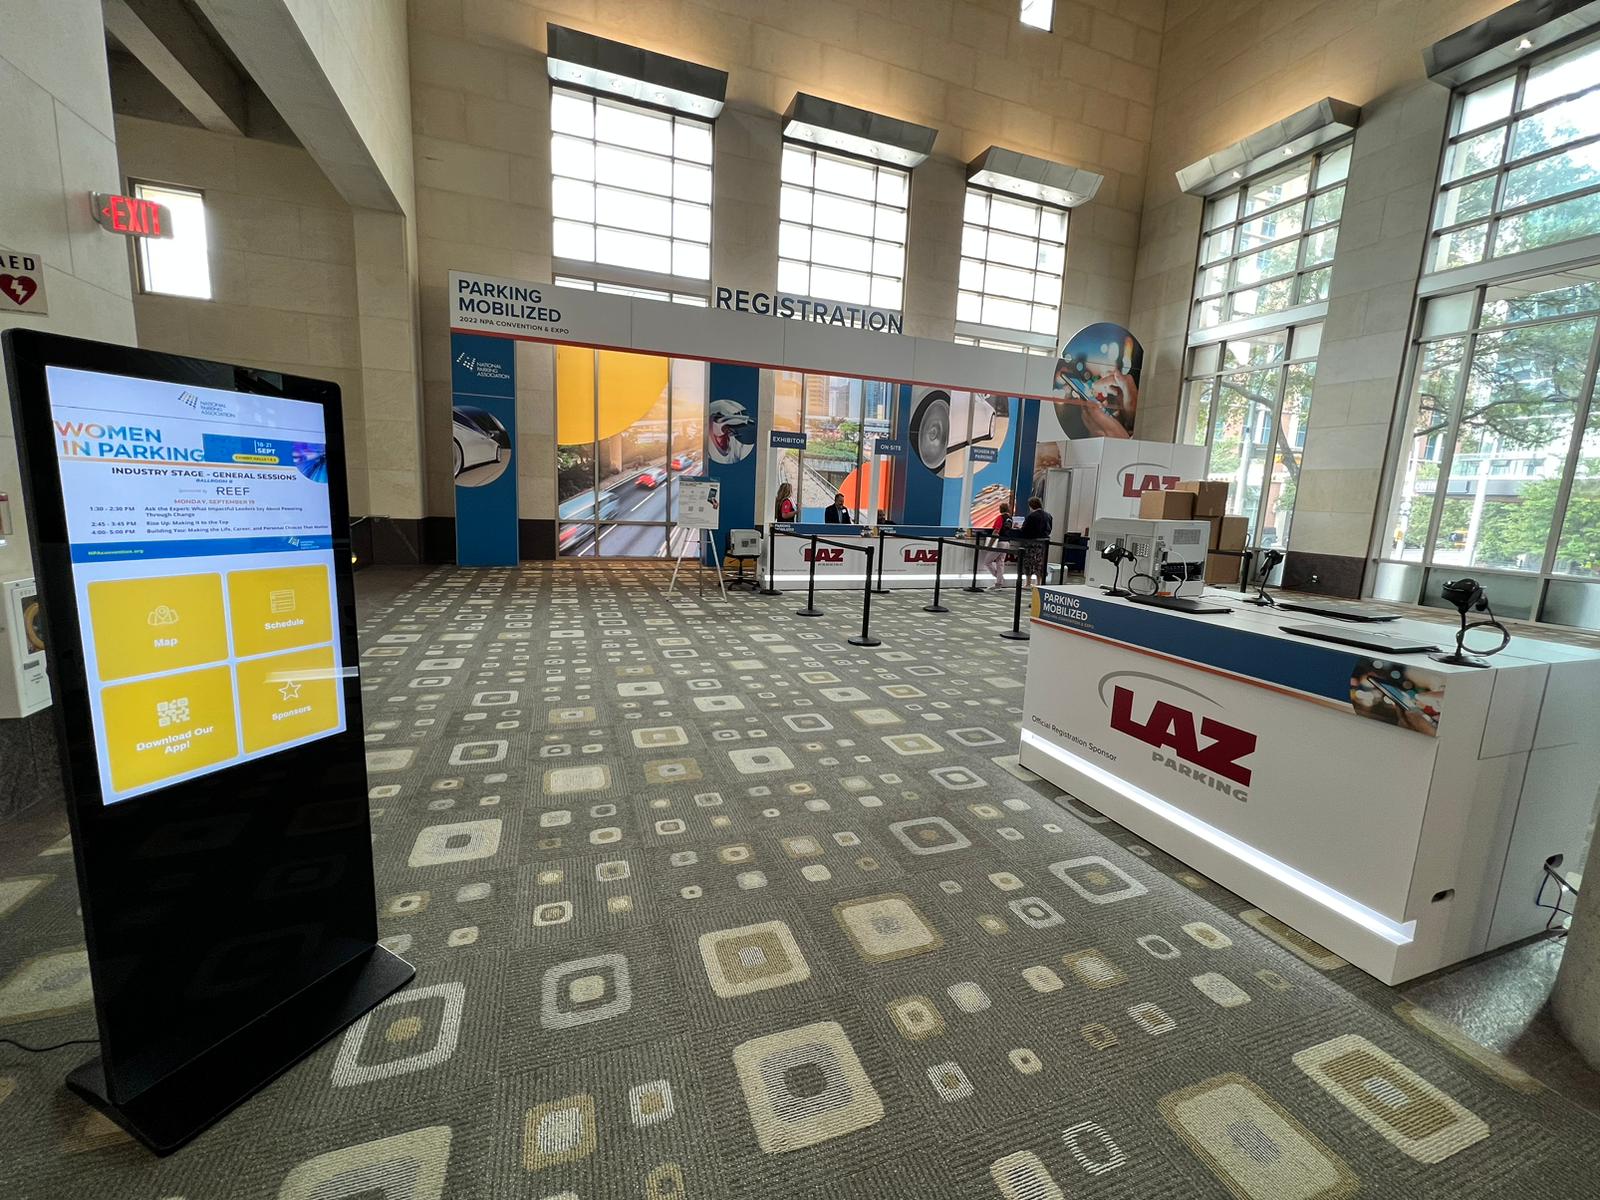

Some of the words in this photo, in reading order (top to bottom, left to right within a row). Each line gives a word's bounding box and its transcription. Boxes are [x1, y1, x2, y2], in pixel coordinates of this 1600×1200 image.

[111, 195, 161, 236] EXIT
[458, 279, 542, 304] PARKING
[458, 297, 562, 323] MOBILIZED
[716, 287, 903, 335] REGISTRATION
[459, 315, 478, 324] 2022
[479, 318, 495, 326] NPA
[495, 319, 543, 332] CONVENTION
[544, 325, 549, 333] &
[550, 327, 570, 335] EXPO
[476, 361, 502, 370] NATIONAL
[476, 371, 511, 380] ASSOCIATION
[54, 421, 162, 443] WOMEN
[772, 436, 805, 445] EXHIBITOR
[62, 440, 92, 457] IN
[98, 442, 205, 463] PARKING
[257, 447, 276, 455] SEPT
[111, 466, 169, 477] INDUSTRY
[171, 469, 204, 479] STAGE
[212, 471, 256, 481] GENERAL
[257, 472, 297, 482] SESSIONS
[216, 486, 250, 496] REEF
[1044, 592, 1080, 609] PARKING
[1043, 602, 1089, 621] MOBILIZED
[264, 617, 304, 631] Schedule
[154, 636, 178, 648] Map
[272, 704, 313, 722] Sponsors
[136, 730, 192, 752] Download
[193, 724, 215, 738] Our
[1031, 714, 1051, 730] Official
[1051, 724, 1088, 748] Registration
[1088, 742, 1117, 761] Sponsor
[1110, 685, 1257, 788] LAZ
[164, 740, 191, 755] App!
[1152, 751, 1248, 803] PARKING
